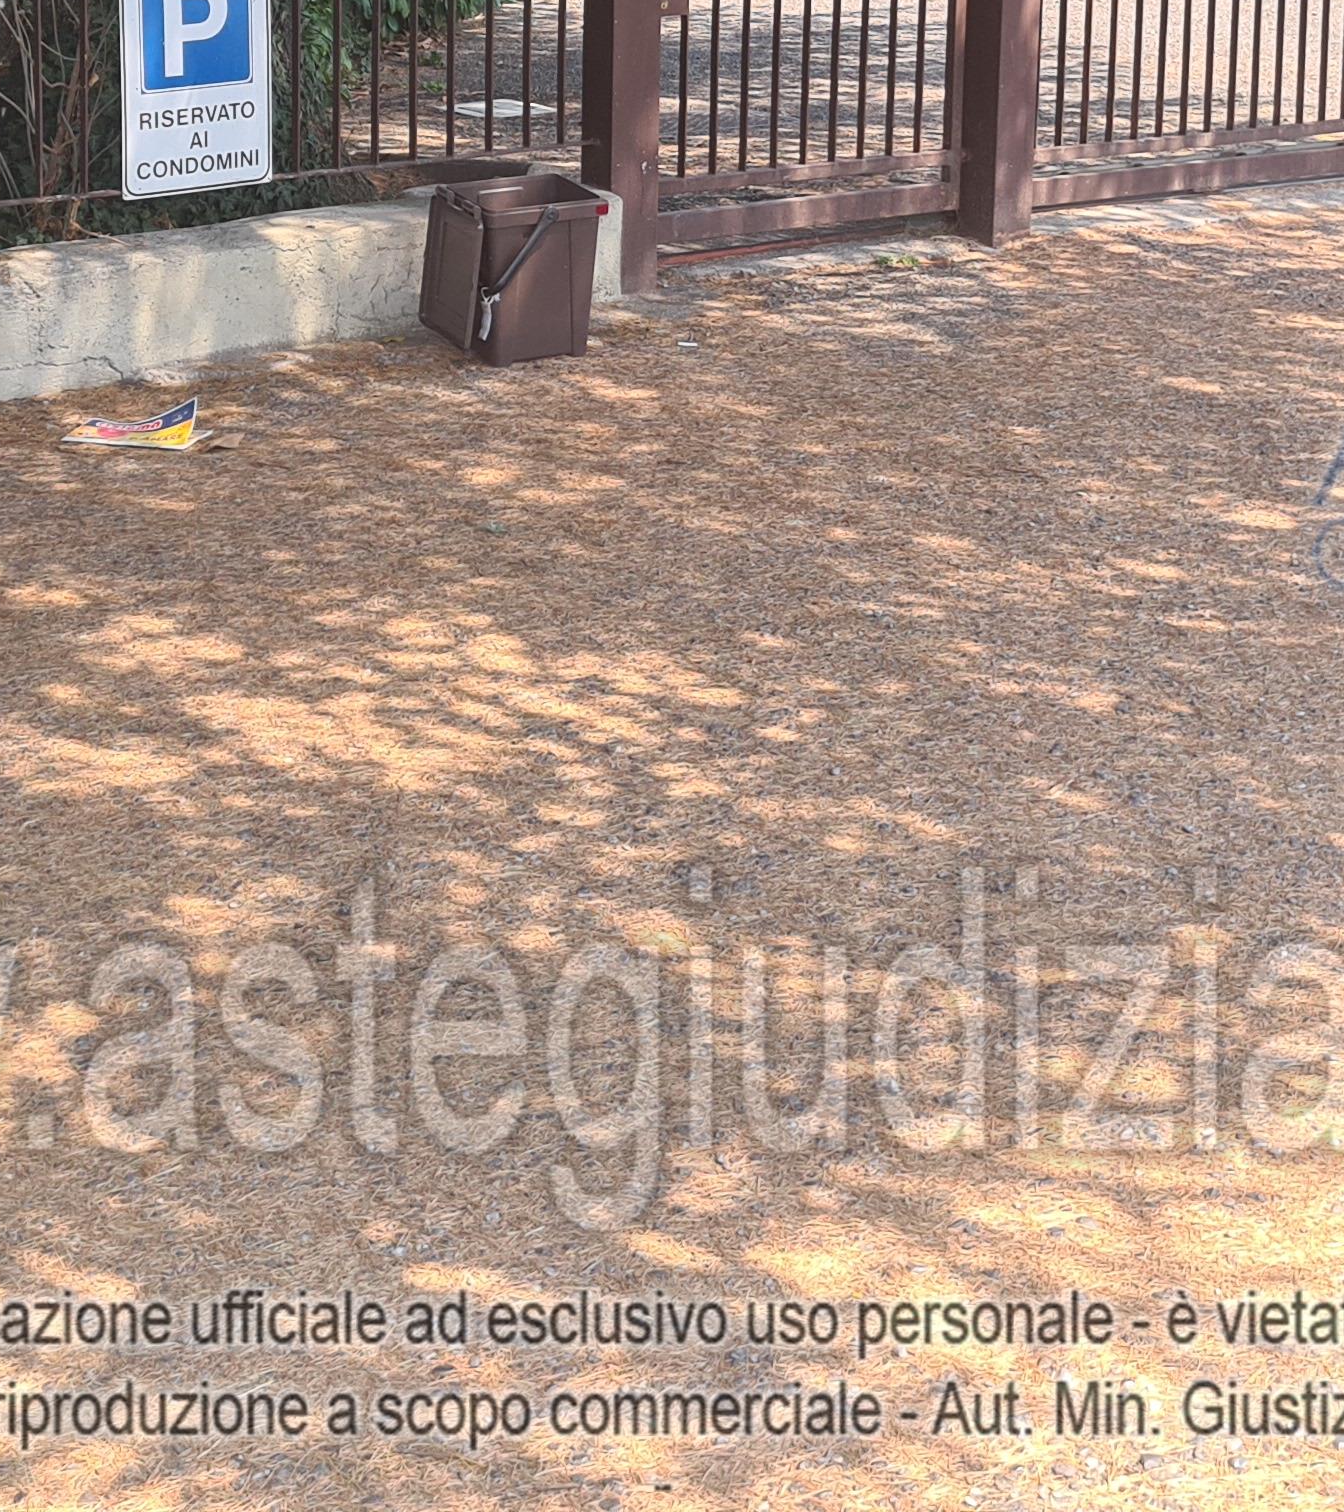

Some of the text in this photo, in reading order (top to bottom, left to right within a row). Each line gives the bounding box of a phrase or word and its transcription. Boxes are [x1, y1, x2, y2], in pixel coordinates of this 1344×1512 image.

[139, 100, 255, 130] RISERVATO
[190, 131, 208, 150] AI
[136, 149, 260, 180] CONDOMINI
